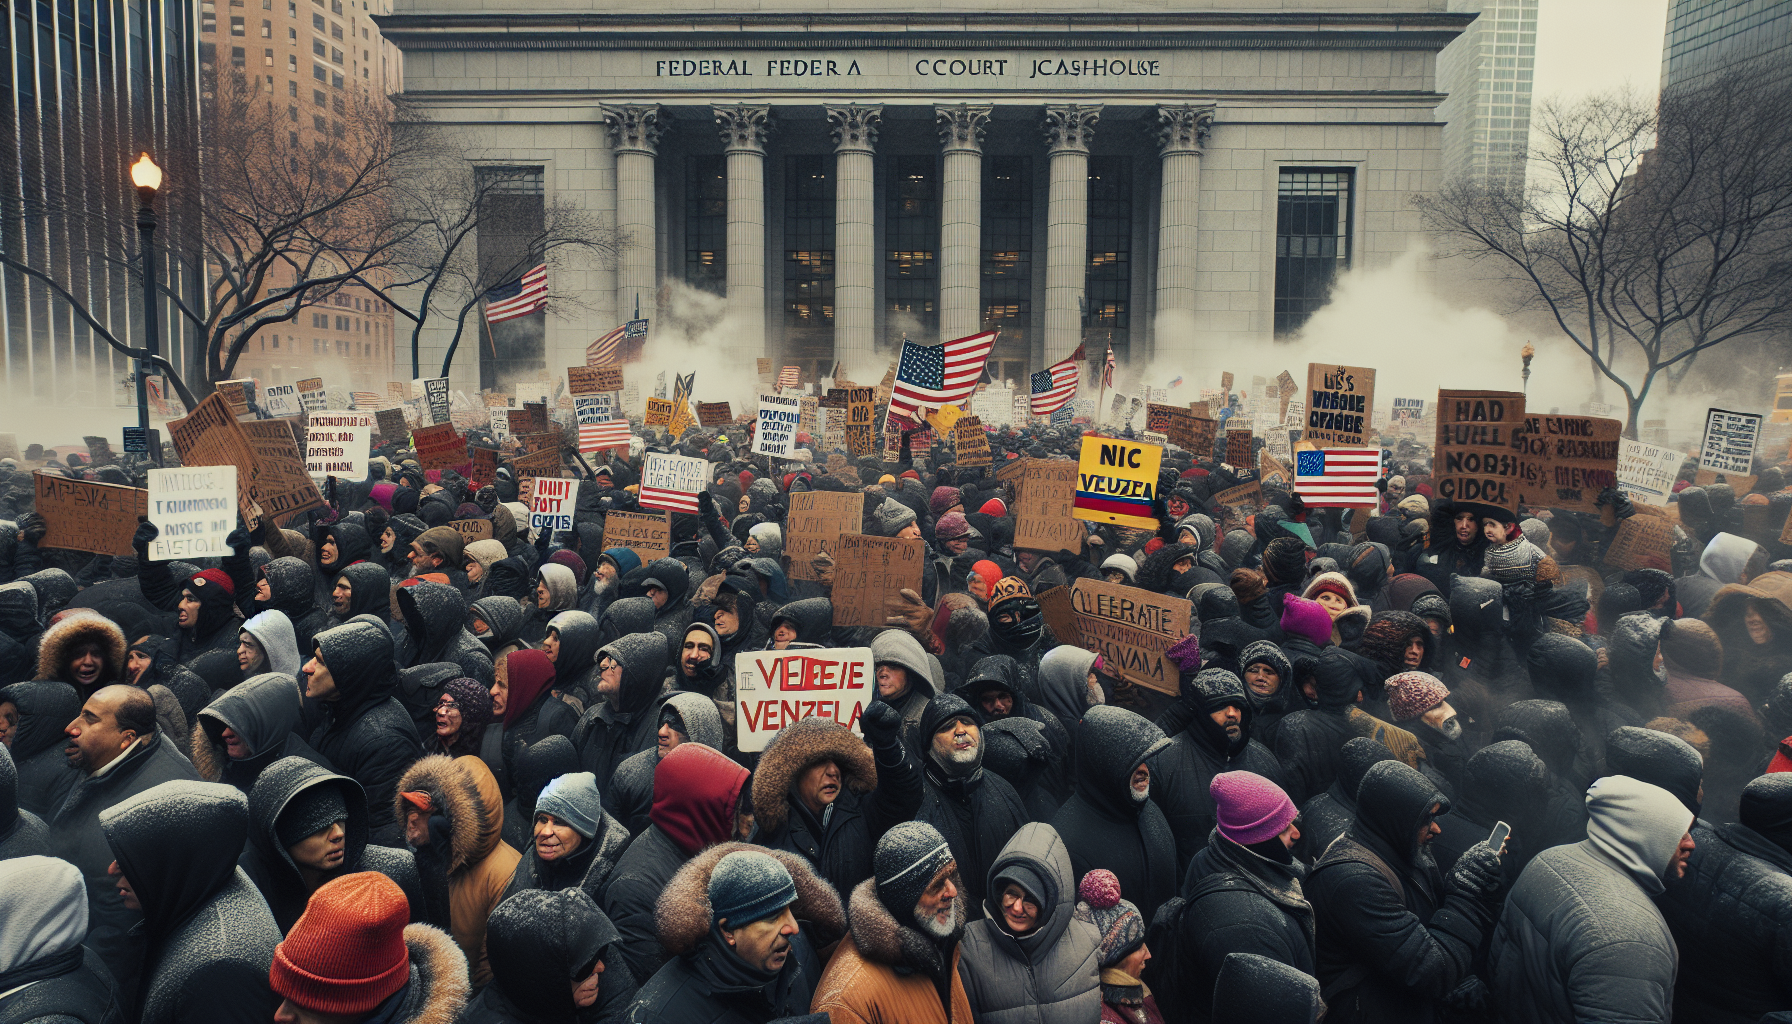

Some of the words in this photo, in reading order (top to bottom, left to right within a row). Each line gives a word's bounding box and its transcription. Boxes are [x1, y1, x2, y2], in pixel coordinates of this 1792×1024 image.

[656, 60, 752, 76] FEDERAL
[1456, 400, 1503, 421] HAD
[1100, 444, 1141, 468] NIC
